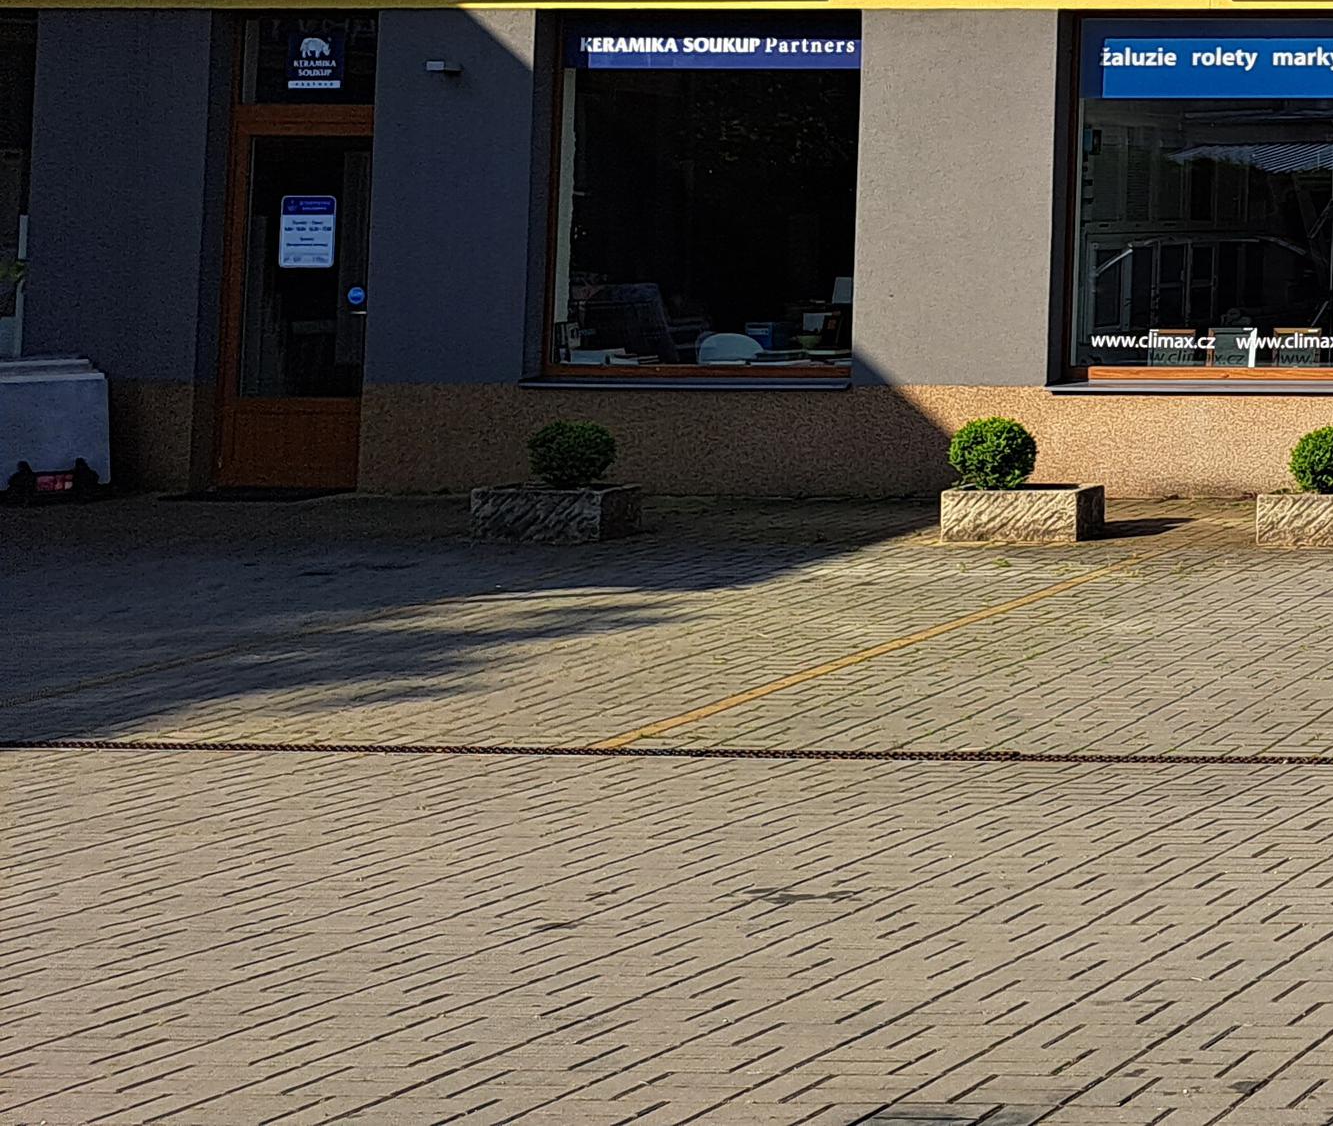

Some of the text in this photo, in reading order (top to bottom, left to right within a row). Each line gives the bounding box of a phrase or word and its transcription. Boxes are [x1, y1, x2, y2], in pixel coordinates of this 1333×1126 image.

[581, 37, 856, 53] KERAMIKA SOUKUP Partners
[1100, 47, 1178, 66] žaluzie
[1192, 47, 1258, 71] rolety
[1091, 331, 1216, 349] www.climax.cz
